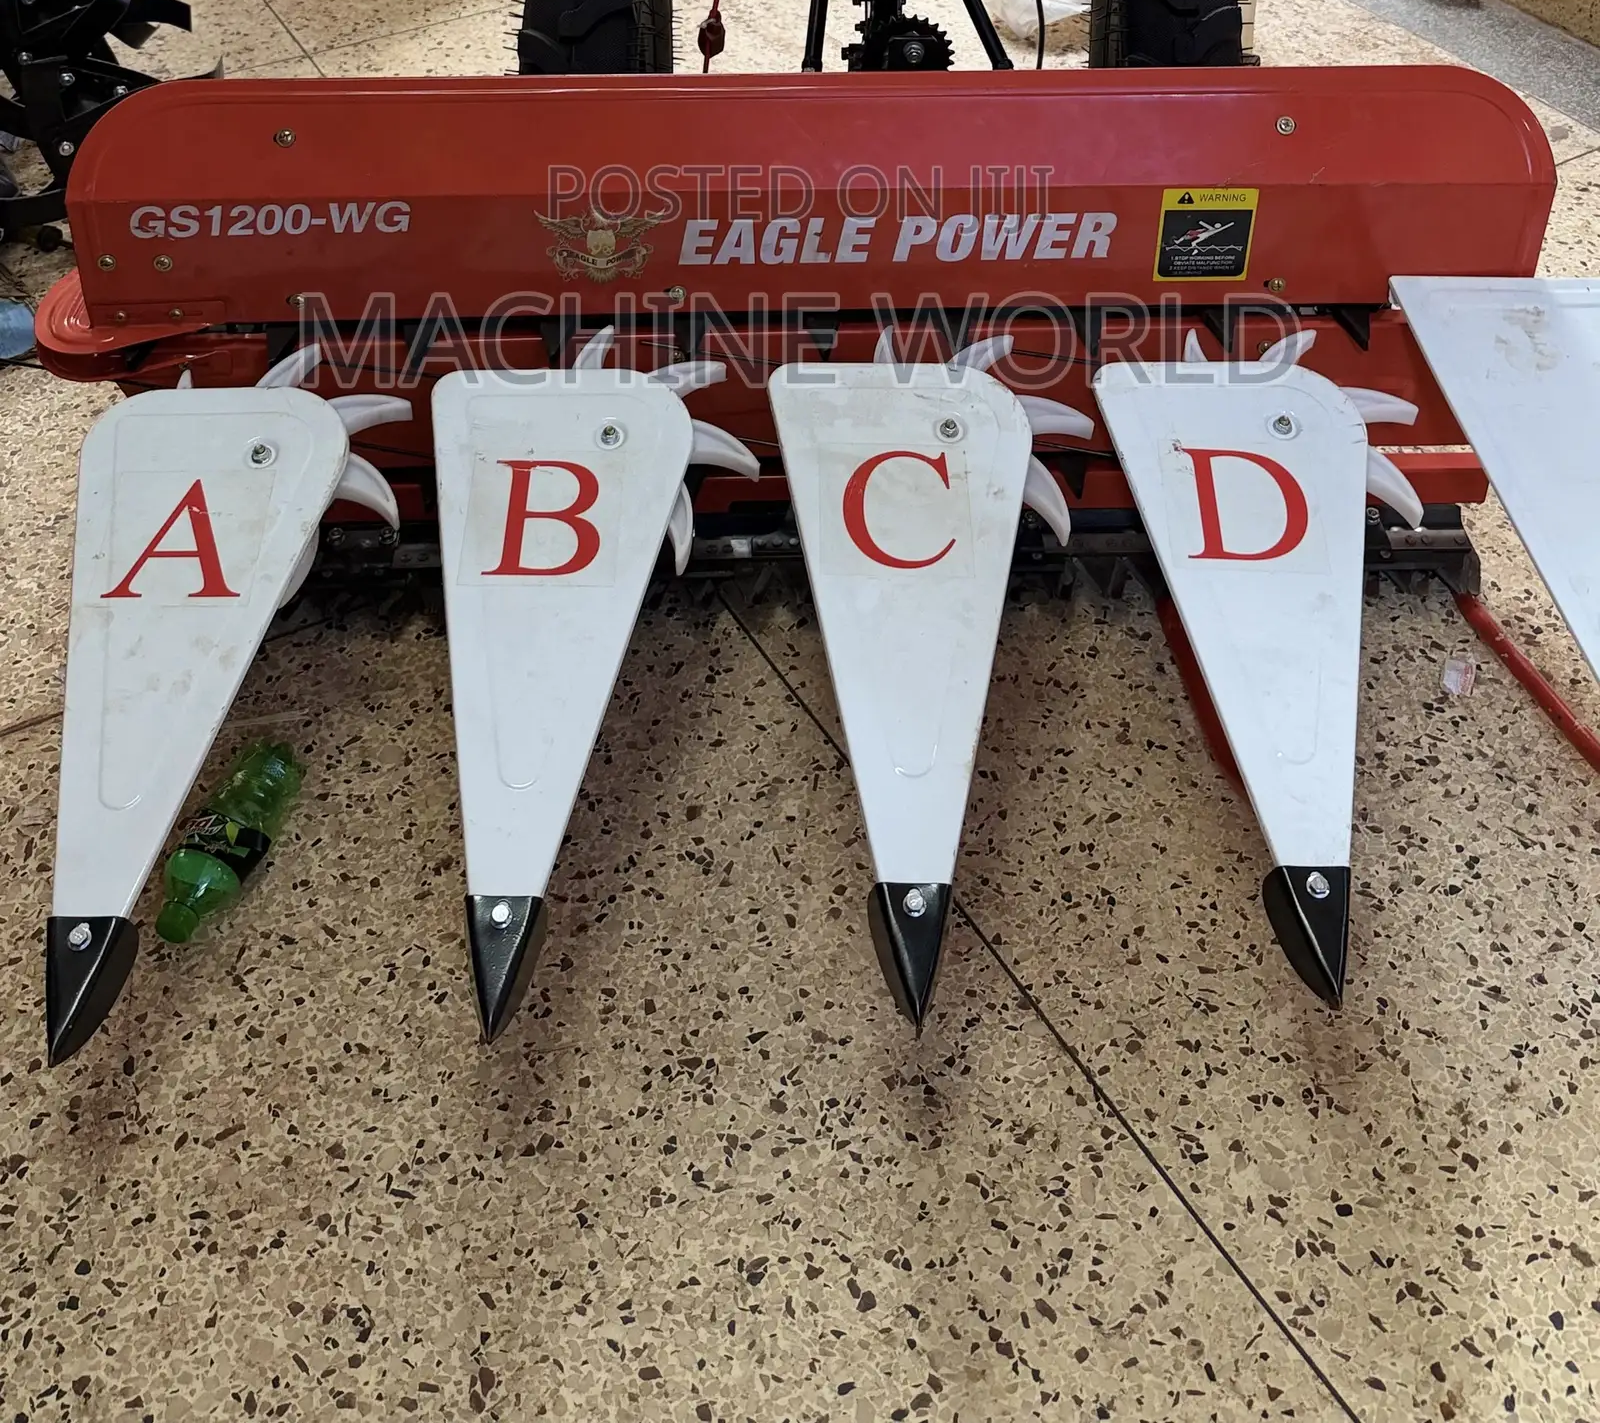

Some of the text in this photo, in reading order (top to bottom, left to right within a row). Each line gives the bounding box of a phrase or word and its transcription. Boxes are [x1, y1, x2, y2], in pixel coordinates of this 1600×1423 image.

[130, 200, 411, 239] GS1200-WG
[678, 212, 1118, 265] EAGLE POWER
[1199, 193, 1247, 202] WARNING
[569, 249, 598, 267] AGLE
[101, 478, 241, 599] A
[480, 459, 601, 577] B
[842, 449, 957, 569] C
[1184, 447, 1309, 561] D
